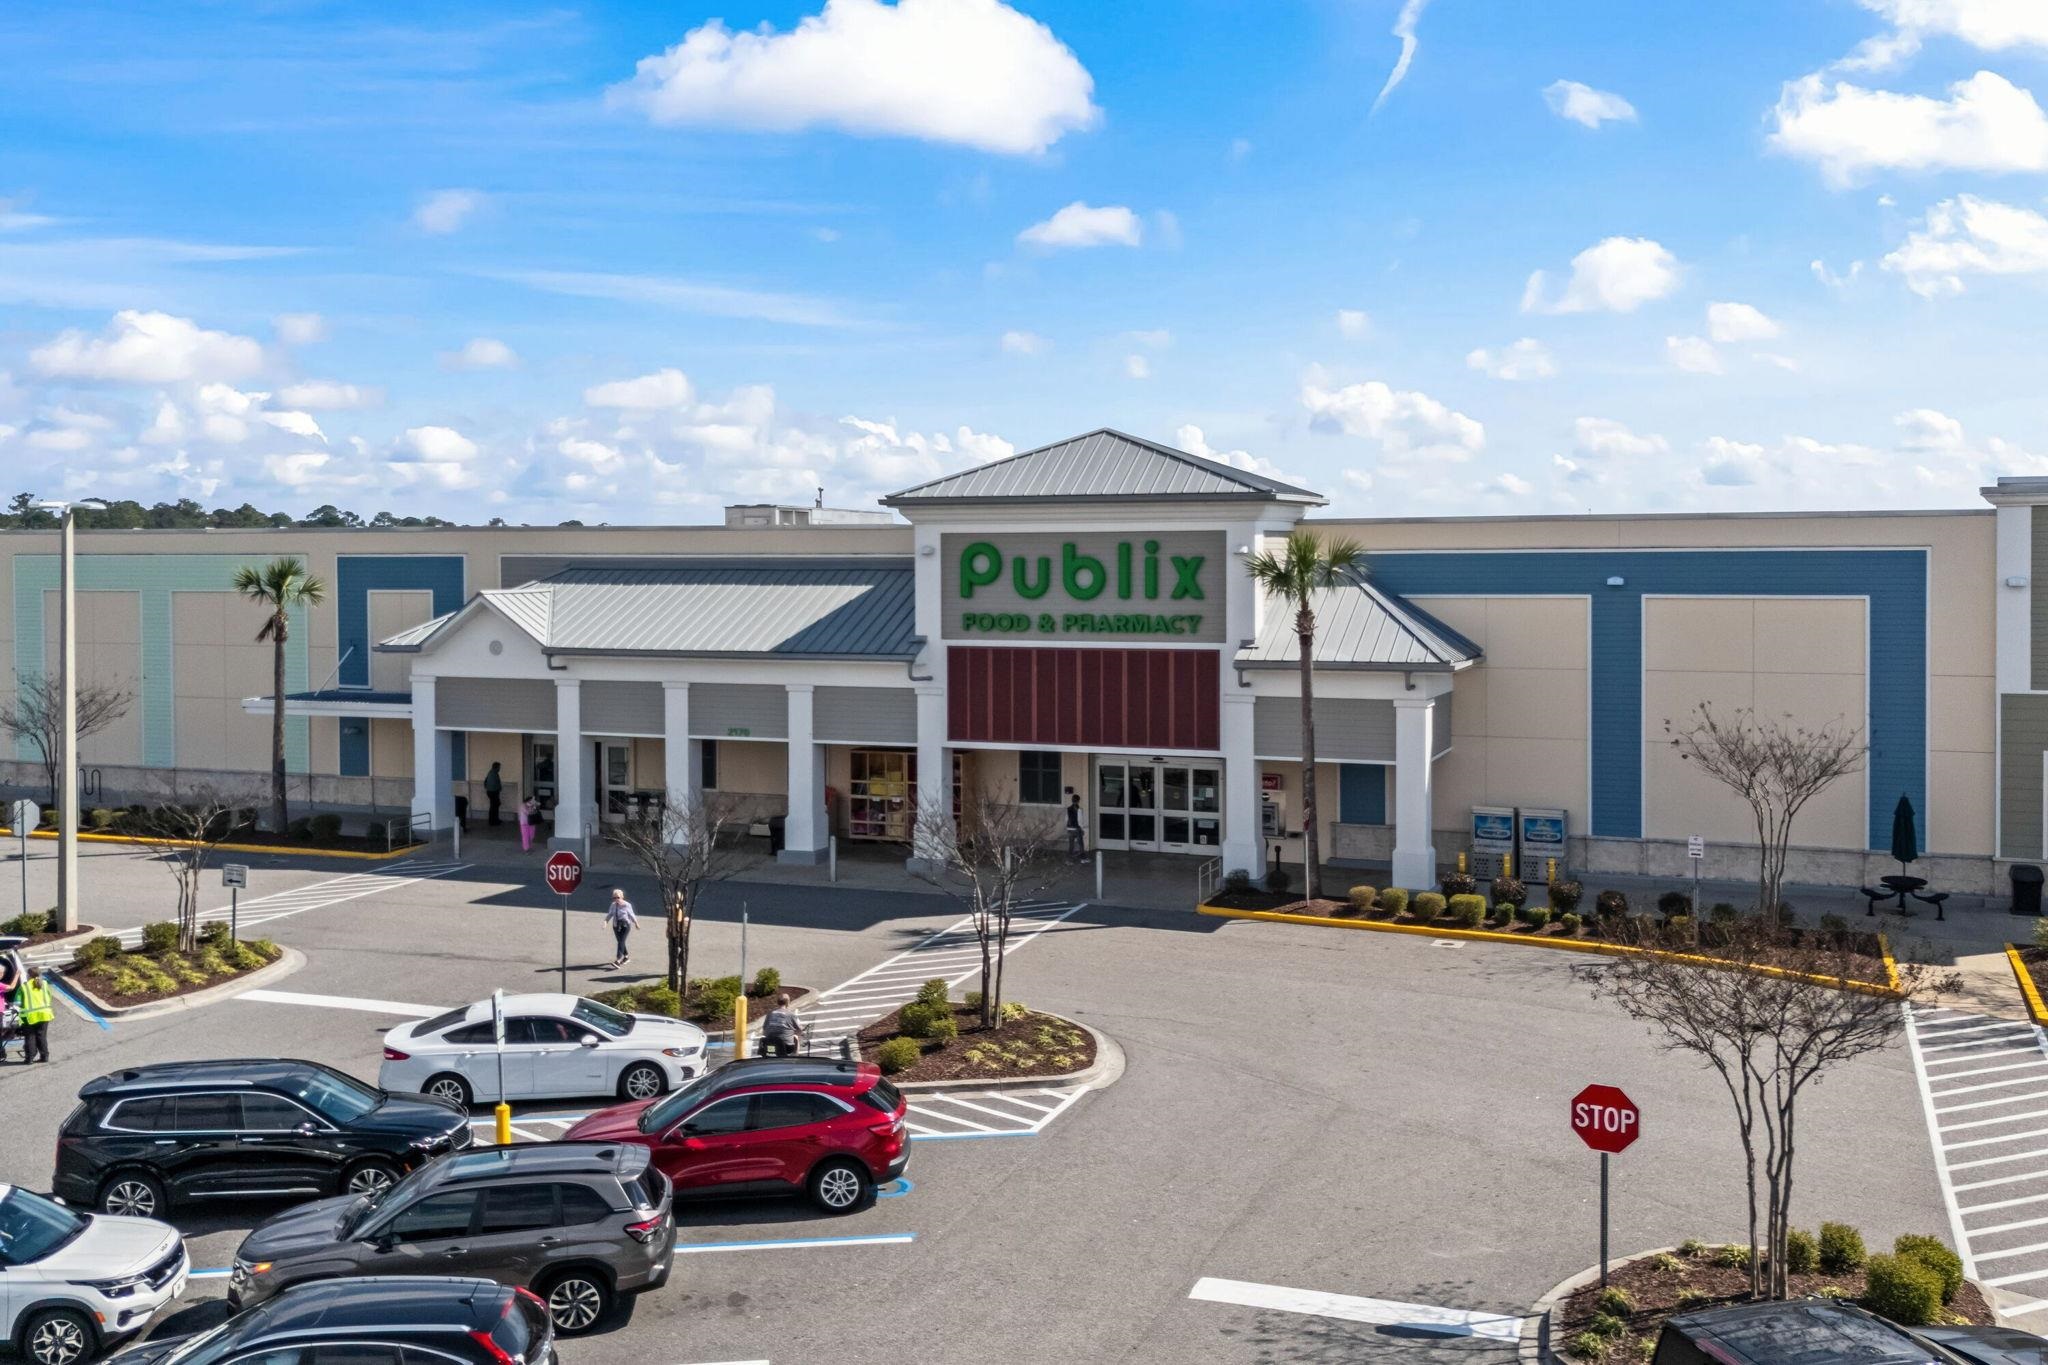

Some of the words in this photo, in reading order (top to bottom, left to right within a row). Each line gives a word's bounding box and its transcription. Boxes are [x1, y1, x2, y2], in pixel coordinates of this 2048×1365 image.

[960, 540, 1204, 600] Publix
[962, 613, 1031, 632] FOOD
[1037, 613, 1056, 633] &
[1062, 613, 1202, 634] PHARMACY
[549, 864, 580, 881] STOP
[1574, 1102, 1636, 1134] STOP
